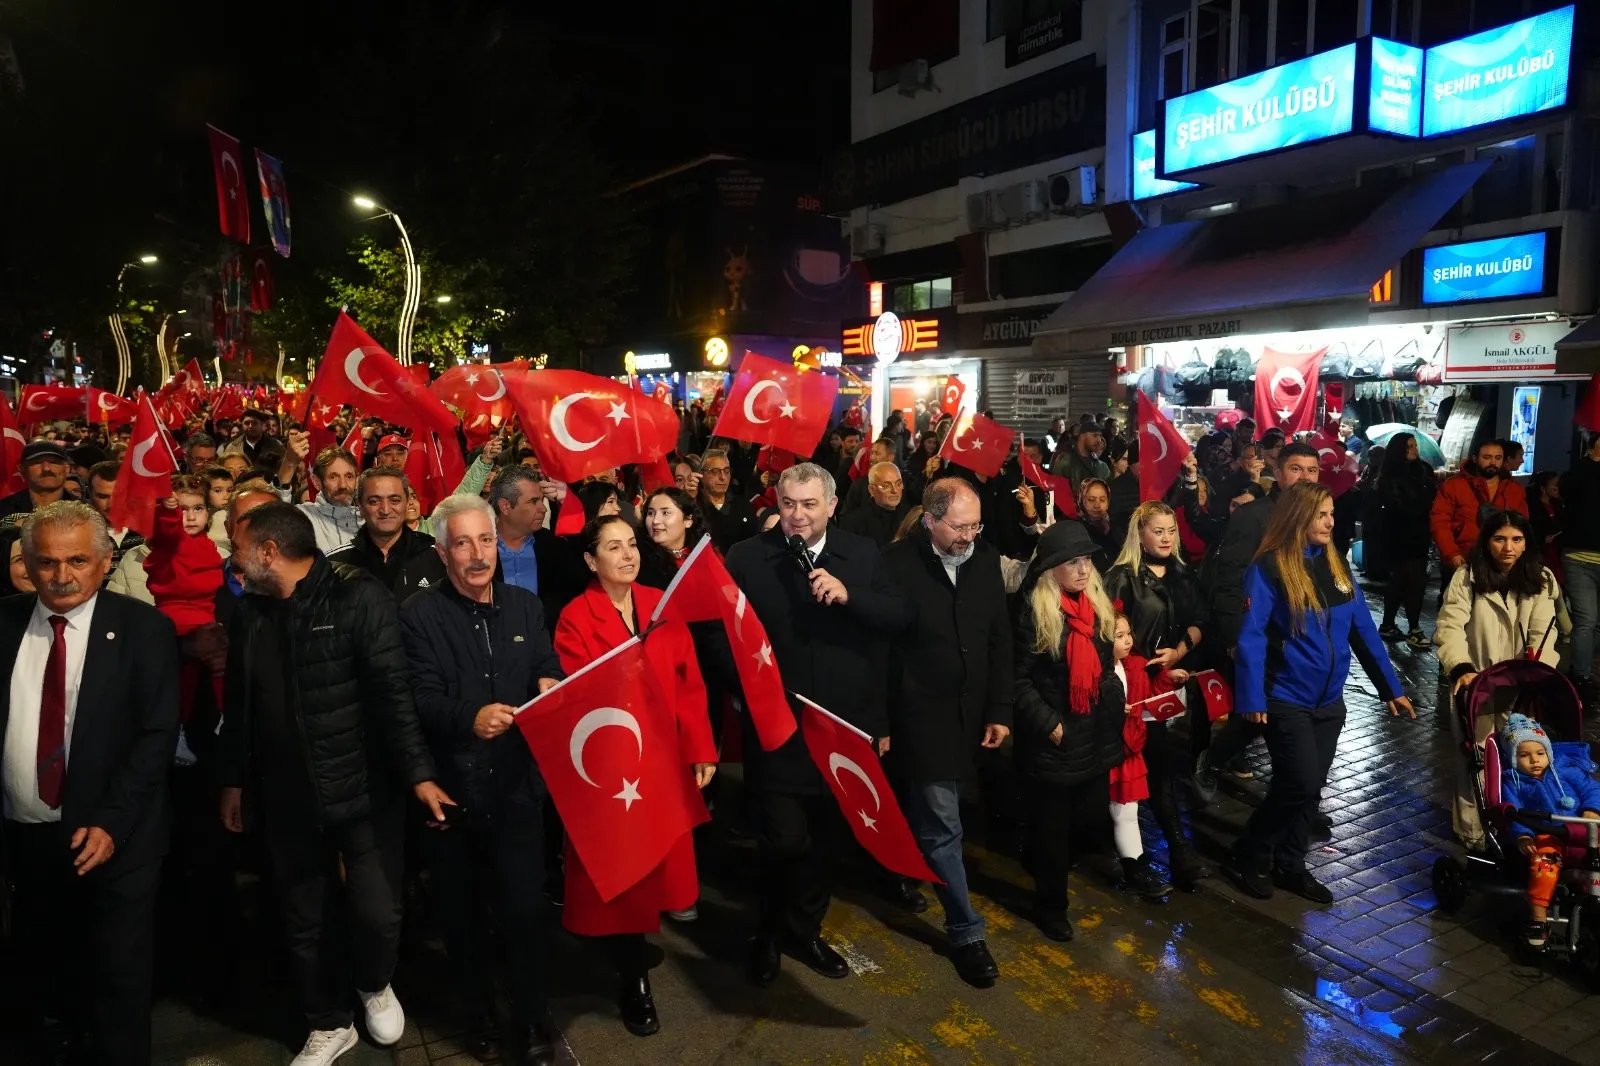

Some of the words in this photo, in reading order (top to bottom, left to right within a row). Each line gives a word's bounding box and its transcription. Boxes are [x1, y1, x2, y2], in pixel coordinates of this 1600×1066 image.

[1434, 72, 1481, 102] ŞEHİR
[1484, 50, 1555, 84] KULÜBÜ
[1006, 86, 1086, 142] KURSU
[1176, 106, 1236, 150] ŞEHİR
[1242, 75, 1336, 128] KULÜBÜ
[1433, 263, 1472, 283] ŞEHİR
[1475, 254, 1533, 277] KULÜBÜ
[1111, 331, 1137, 344] BOLU
[1142, 325, 1192, 341] UCUZLUK
[1198, 320, 1241, 335] PAZARI
[1484, 346, 1510, 357] İsmail
[1511, 344, 1550, 356] AKGÜL
